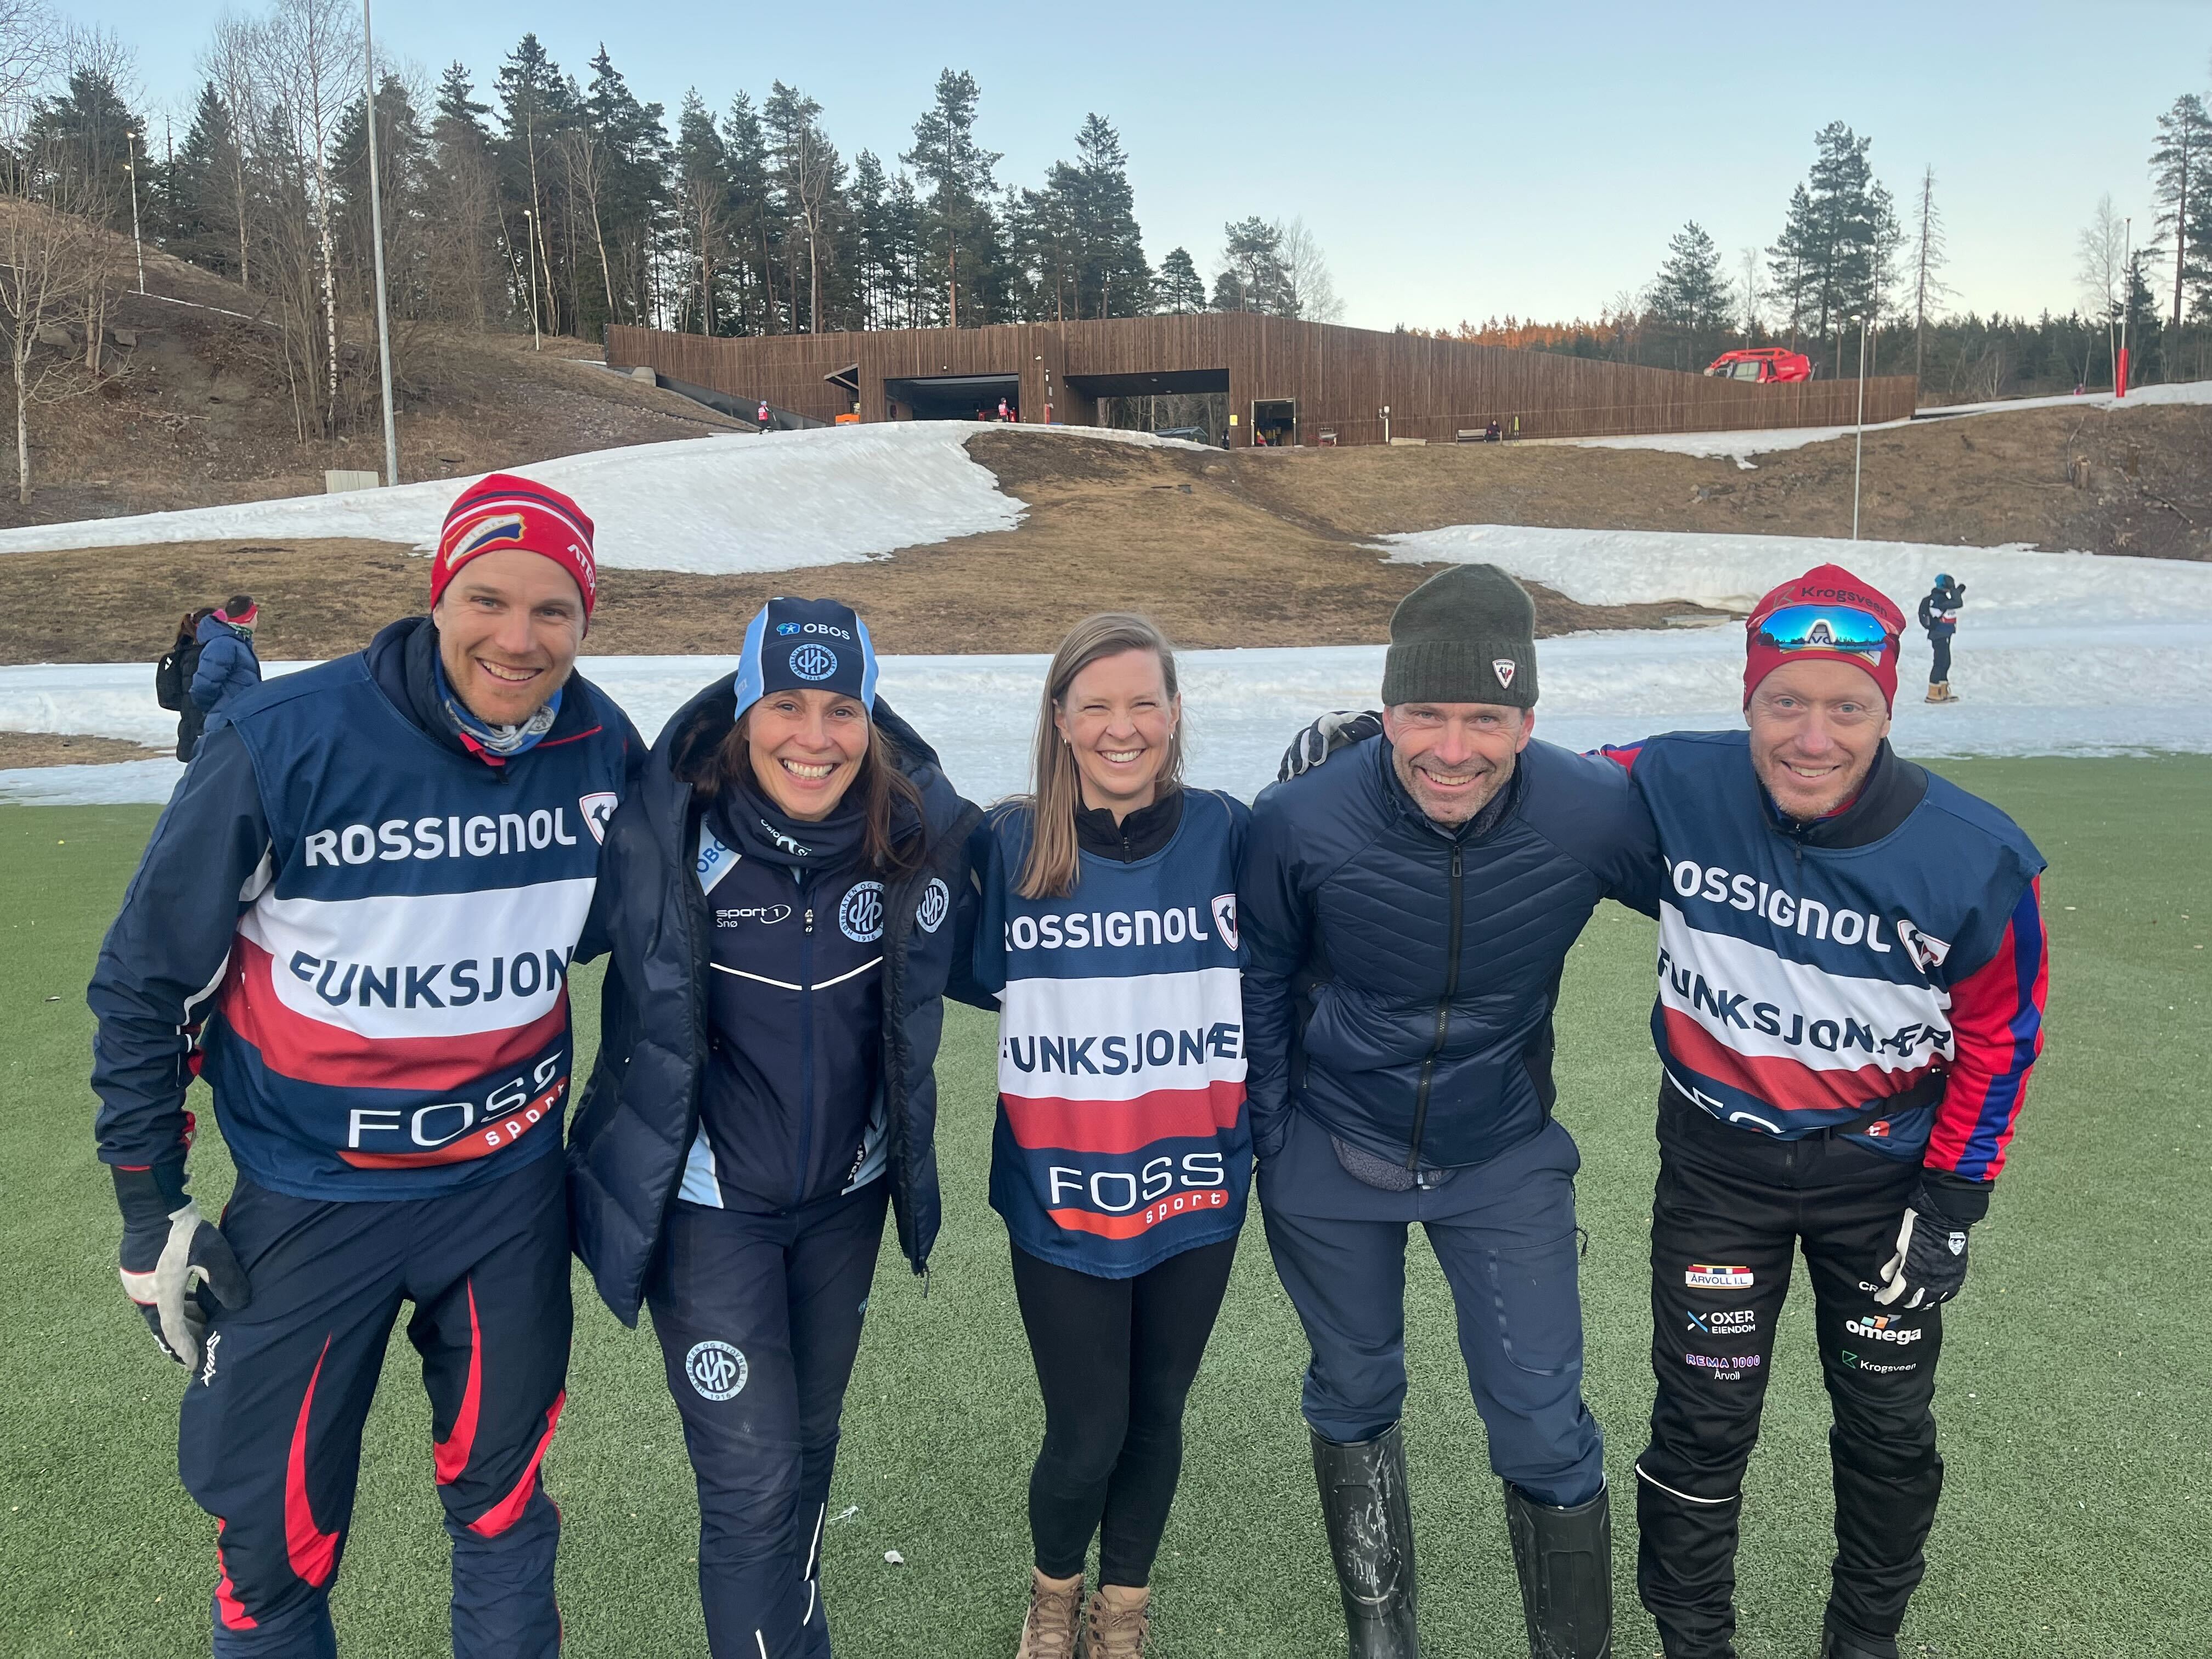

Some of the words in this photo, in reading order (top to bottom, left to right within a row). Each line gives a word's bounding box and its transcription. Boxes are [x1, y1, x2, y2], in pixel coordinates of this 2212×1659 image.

[1802, 586, 1887, 617] Krogsveen
[804, 623, 850, 640] OBOS
[305, 807, 577, 867] ROSSIGNOL
[716, 907, 768, 918] sport
[1663, 854, 1891, 953] OSSIGNOL
[716, 918, 738, 928] Snø
[1003, 1022, 1247, 1075] UNKSJONÆ
[485, 1084, 565, 1147] sport
[1049, 1152, 1224, 1211] FOSS
[1146, 1191, 1221, 1224] sport
[1691, 1273, 1732, 1285] ÅRVOLL
[1711, 1310, 1754, 1324] OXER
[1712, 1324, 1756, 1334] EIENDOM
[1846, 1320, 1921, 1345] omega
[200, 1330, 221, 1387] Swix
[720, 1344, 746, 1374] STOVNER
[1686, 1353, 1729, 1368] REMA
[1732, 1355, 1760, 1368] 1000
[1860, 1360, 1916, 1374] Krogsveen
[1714, 1368, 1740, 1380] Årvoll
